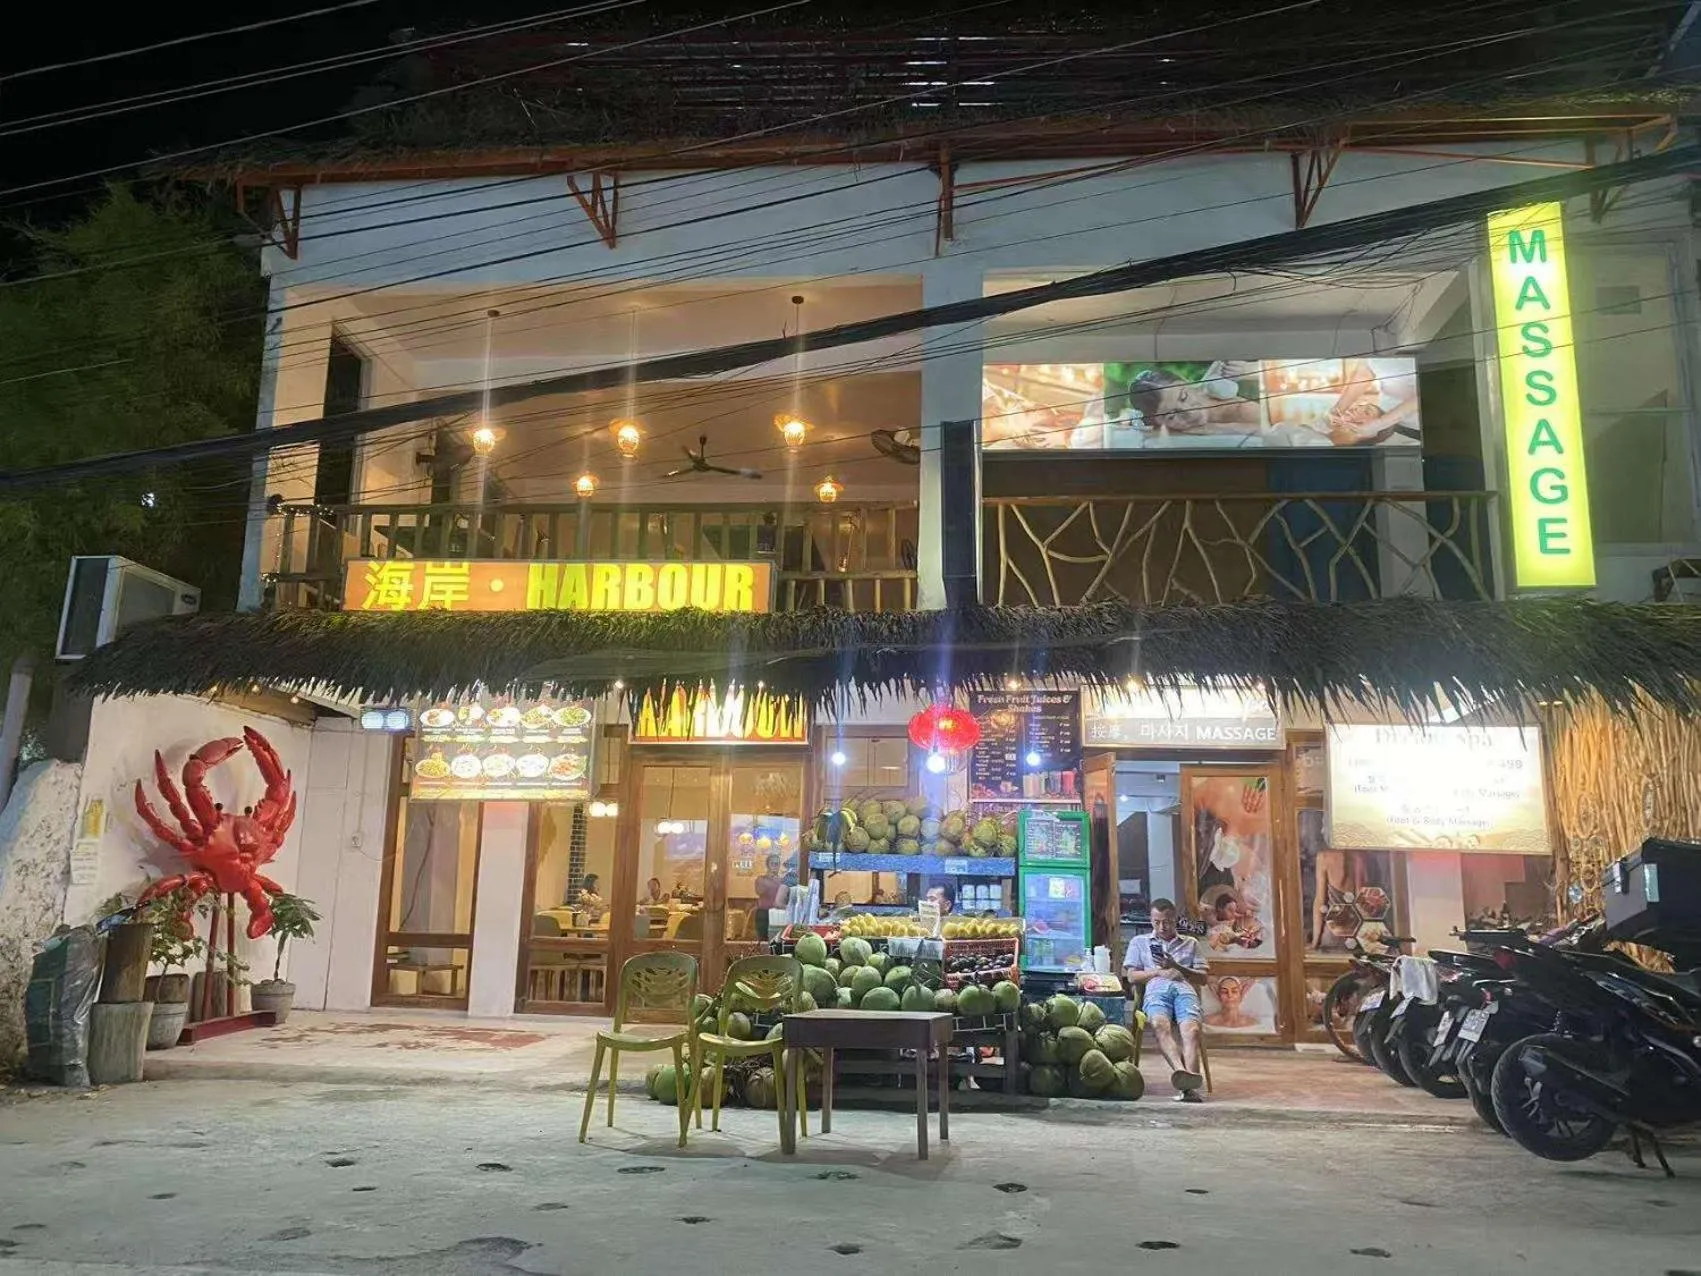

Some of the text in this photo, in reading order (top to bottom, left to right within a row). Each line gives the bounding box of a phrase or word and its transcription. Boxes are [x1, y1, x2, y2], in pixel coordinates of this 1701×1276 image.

[1507, 229, 1572, 555] MASSAGE
[361, 560, 472, 610] 海岸
[525, 562, 755, 610] HARBOUR
[1195, 725, 1277, 741] MASSAGE
